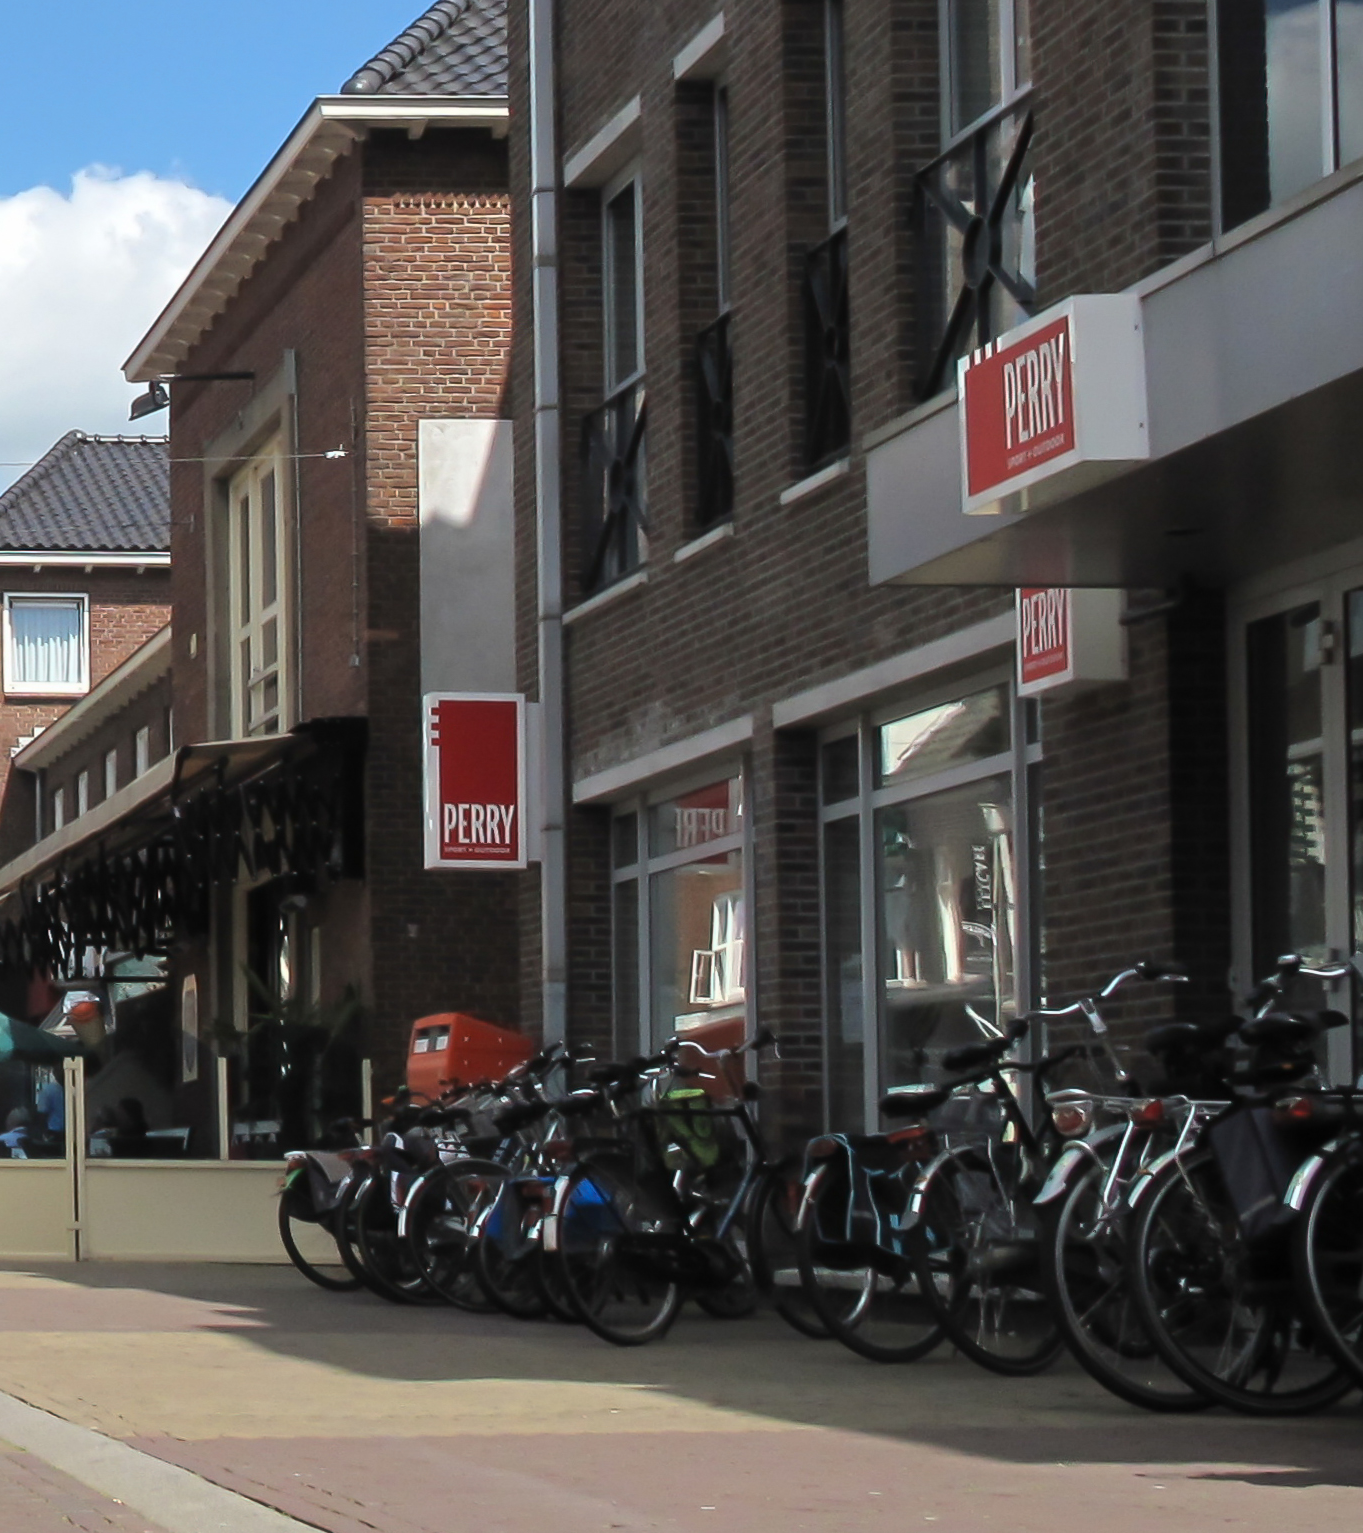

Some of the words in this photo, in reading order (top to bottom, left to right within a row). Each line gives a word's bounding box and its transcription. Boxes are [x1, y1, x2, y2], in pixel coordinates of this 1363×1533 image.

[1003, 331, 1065, 450] PERRY
[1022, 589, 1064, 658] PERRY
[444, 803, 515, 845] PERRY
